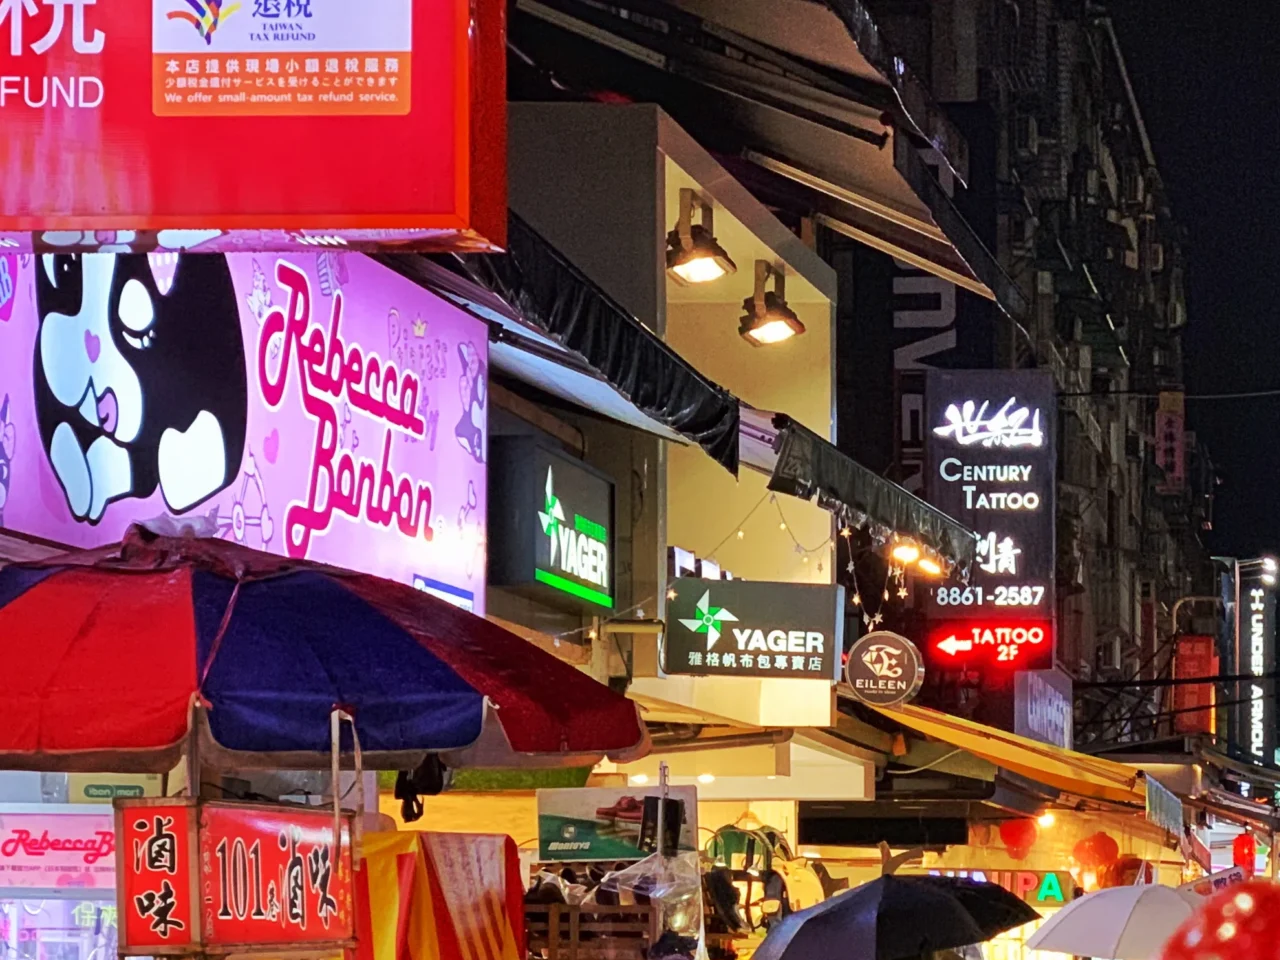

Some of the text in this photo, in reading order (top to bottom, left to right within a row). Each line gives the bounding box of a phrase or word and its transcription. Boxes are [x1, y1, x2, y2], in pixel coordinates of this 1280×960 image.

[273, 32, 316, 41] REFUND
[164, 92, 399, 103] We offer small-amount tax refund service.
[258, 262, 425, 436] Rebecca
[285, 396, 434, 560] Bonbon
[940, 458, 1032, 482] CENTURY
[962, 485, 1040, 510] TATTOO
[558, 523, 608, 588] YAGER
[936, 587, 1045, 606] 8861-2587
[732, 629, 825, 653] YAGER
[971, 627, 1044, 645] TATTOO
[997, 644, 1018, 661] 2F
[1251, 684, 1264, 766] ARMOU
[133, 816, 184, 938] 滷味
